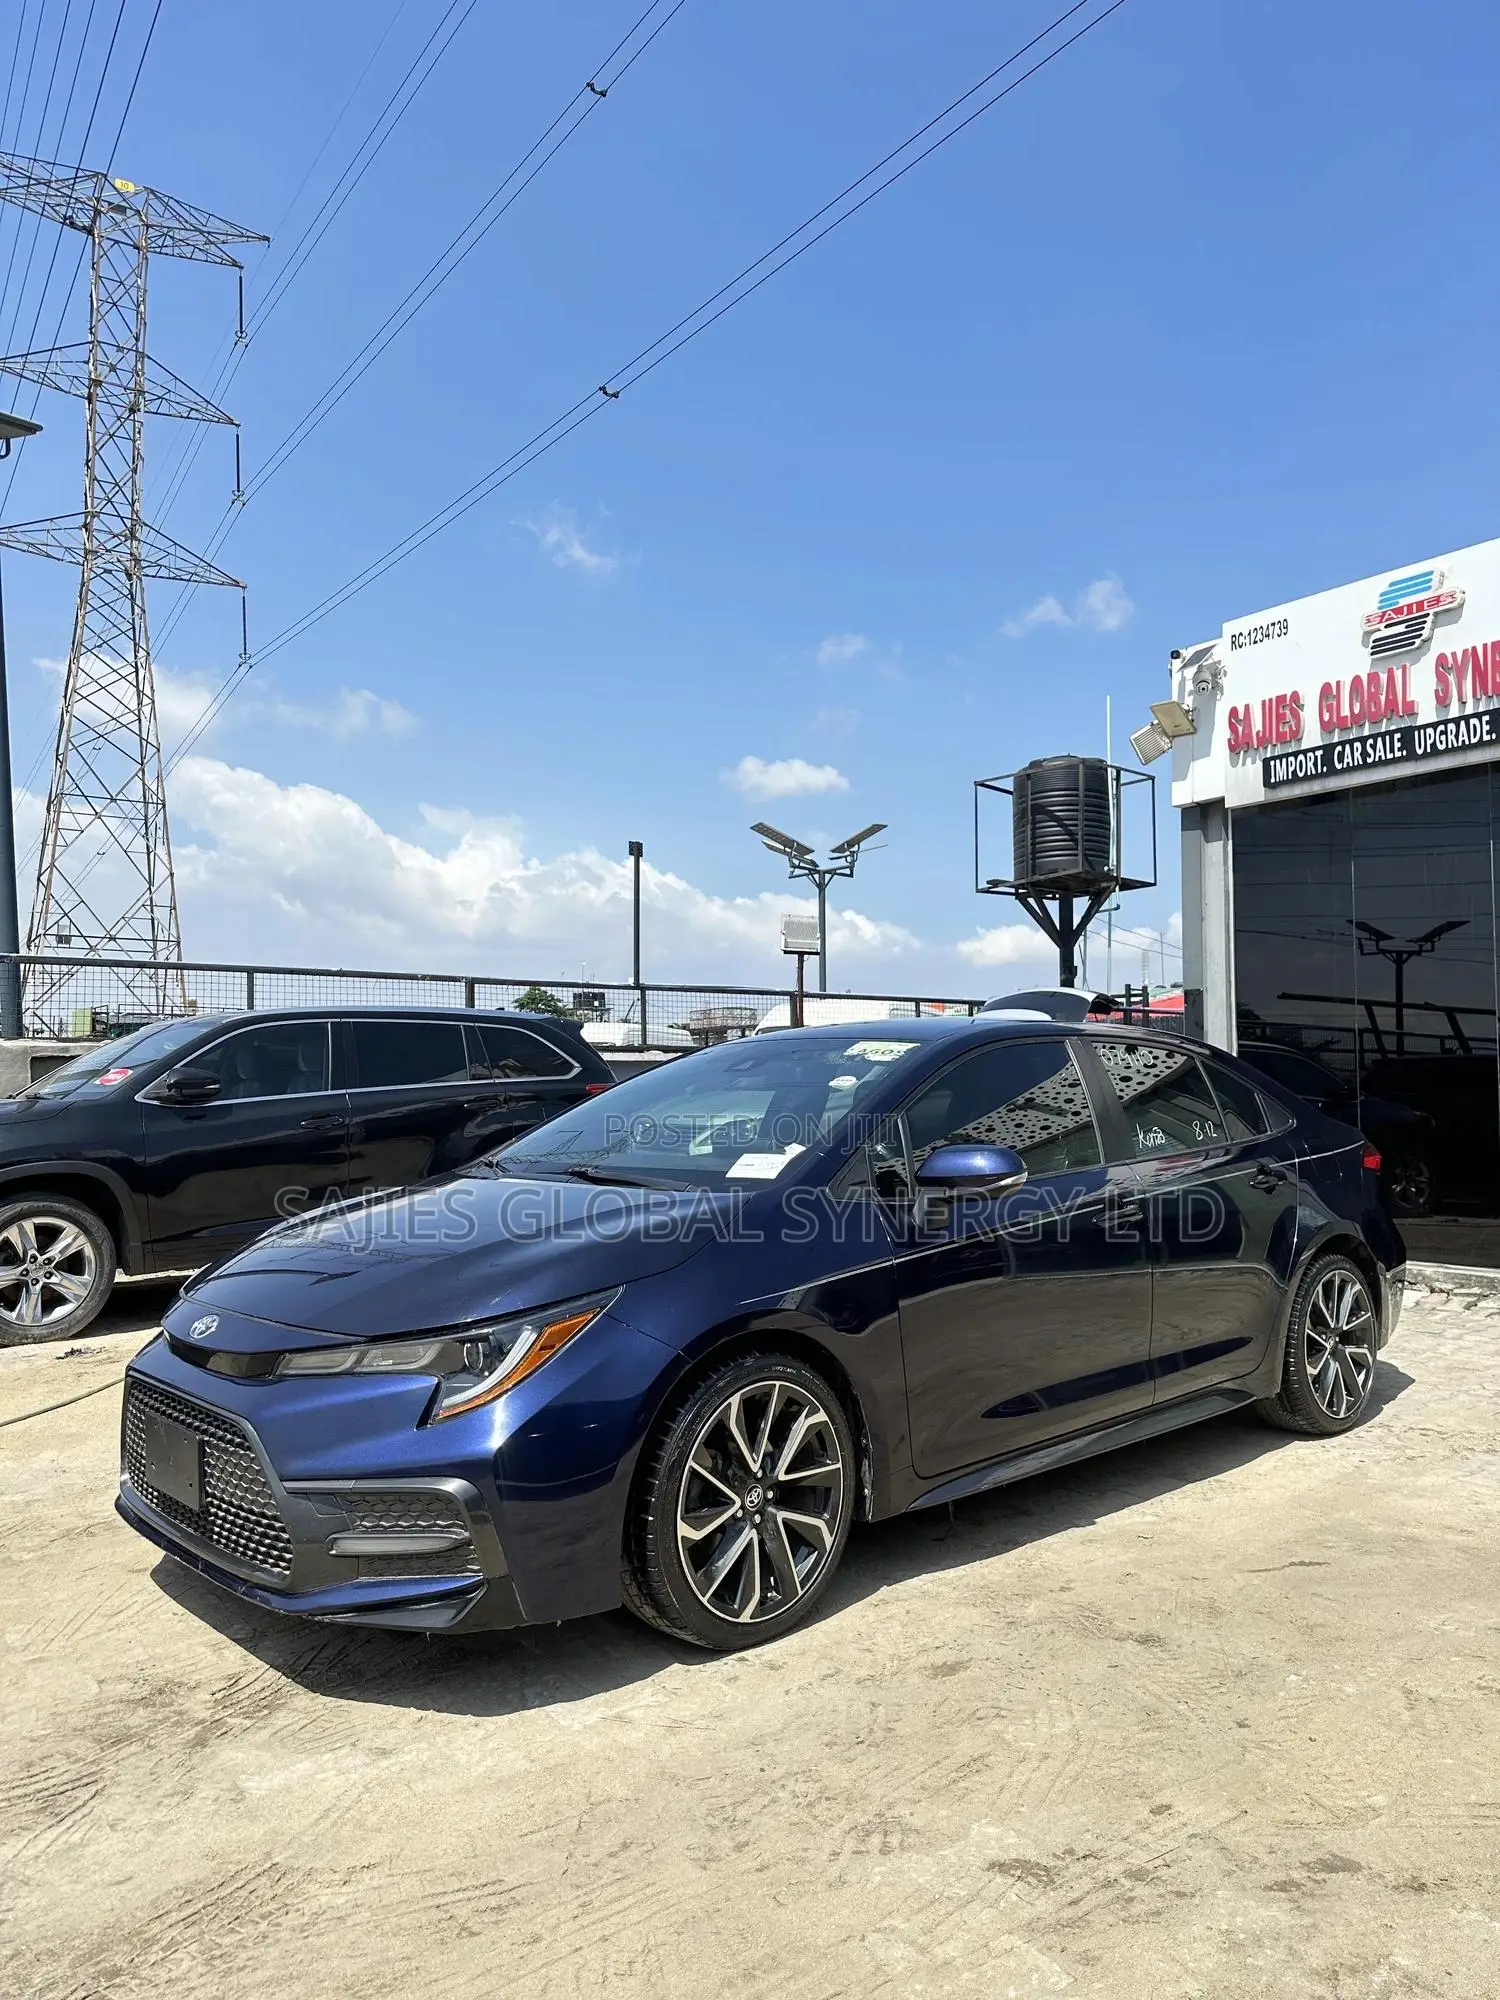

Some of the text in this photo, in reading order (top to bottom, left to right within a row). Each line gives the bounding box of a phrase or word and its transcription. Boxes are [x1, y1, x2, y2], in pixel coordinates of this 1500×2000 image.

[120, 182, 129, 190] 10
[1364, 590, 1457, 626] SAJIES
[1230, 618, 1289, 652] RC:1234739
[1227, 690, 1304, 755] SAJIES
[1318, 664, 1419, 734] GLOBAL
[1269, 714, 1496, 783] IMPORT. CAR SALE. UPGRADE.
